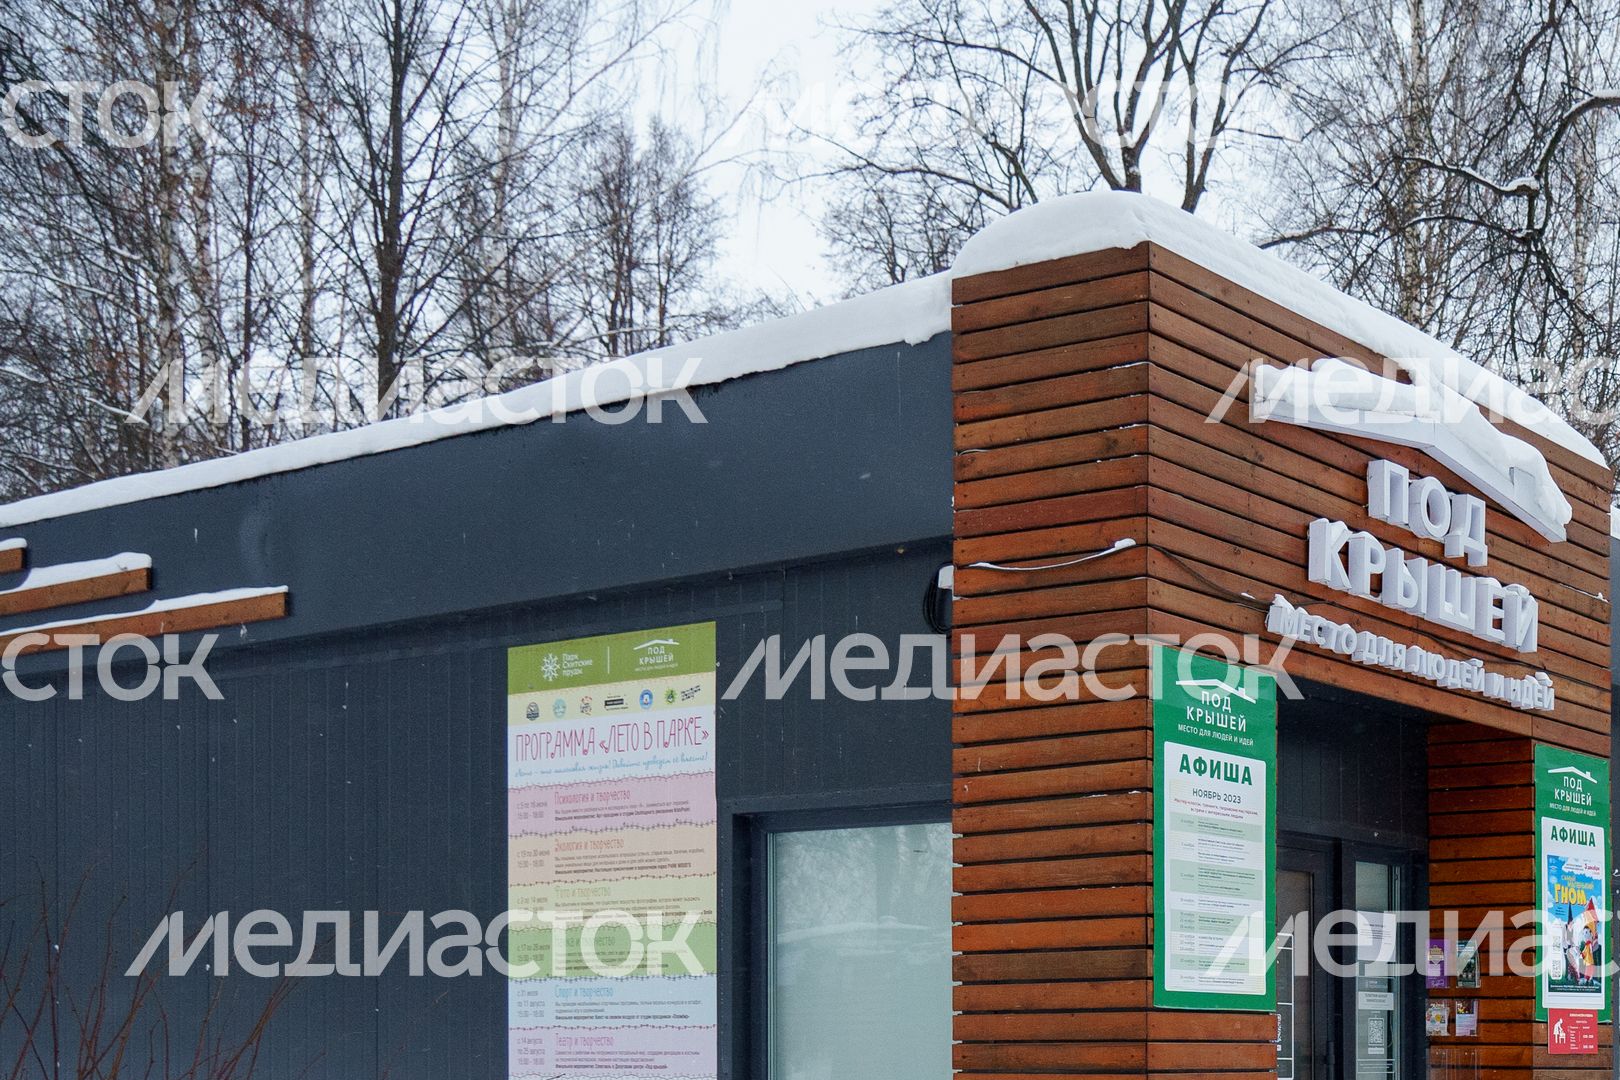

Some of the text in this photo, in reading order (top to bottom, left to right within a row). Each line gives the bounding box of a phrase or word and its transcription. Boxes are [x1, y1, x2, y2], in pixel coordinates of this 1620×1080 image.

[1367, 459, 1488, 566] ПОД
[1308, 518, 1539, 653] КРЫШЕЙ
[639, 653, 674, 665] КРЫШЕЙ
[648, 647, 665, 655] ПОД
[1265, 594, 1555, 711] МЕСТО ДЛЯ ЛЮДЕЙ И ИДЕЙ
[1201, 691, 1231, 713] ПОД
[1186, 706, 1247, 732] КРЫШЕЙ
[515, 716, 709, 762] ПРОГРАММА «ЛЕТО В ПАРКЕ»
[1178, 724, 1254, 746] МЕСТО ДЛЯ ЛЮДЕЙ И ИДЕЙ
[1179, 754, 1252, 785] АФИША
[1563, 776, 1583, 792] ПОД
[1192, 788, 1242, 804] НОЯБРЬ 2023
[1554, 788, 1592, 806] КРЫШЕЙ
[1551, 825, 1595, 847] АФИША
[1554, 883, 1588, 906] ГНОМ
